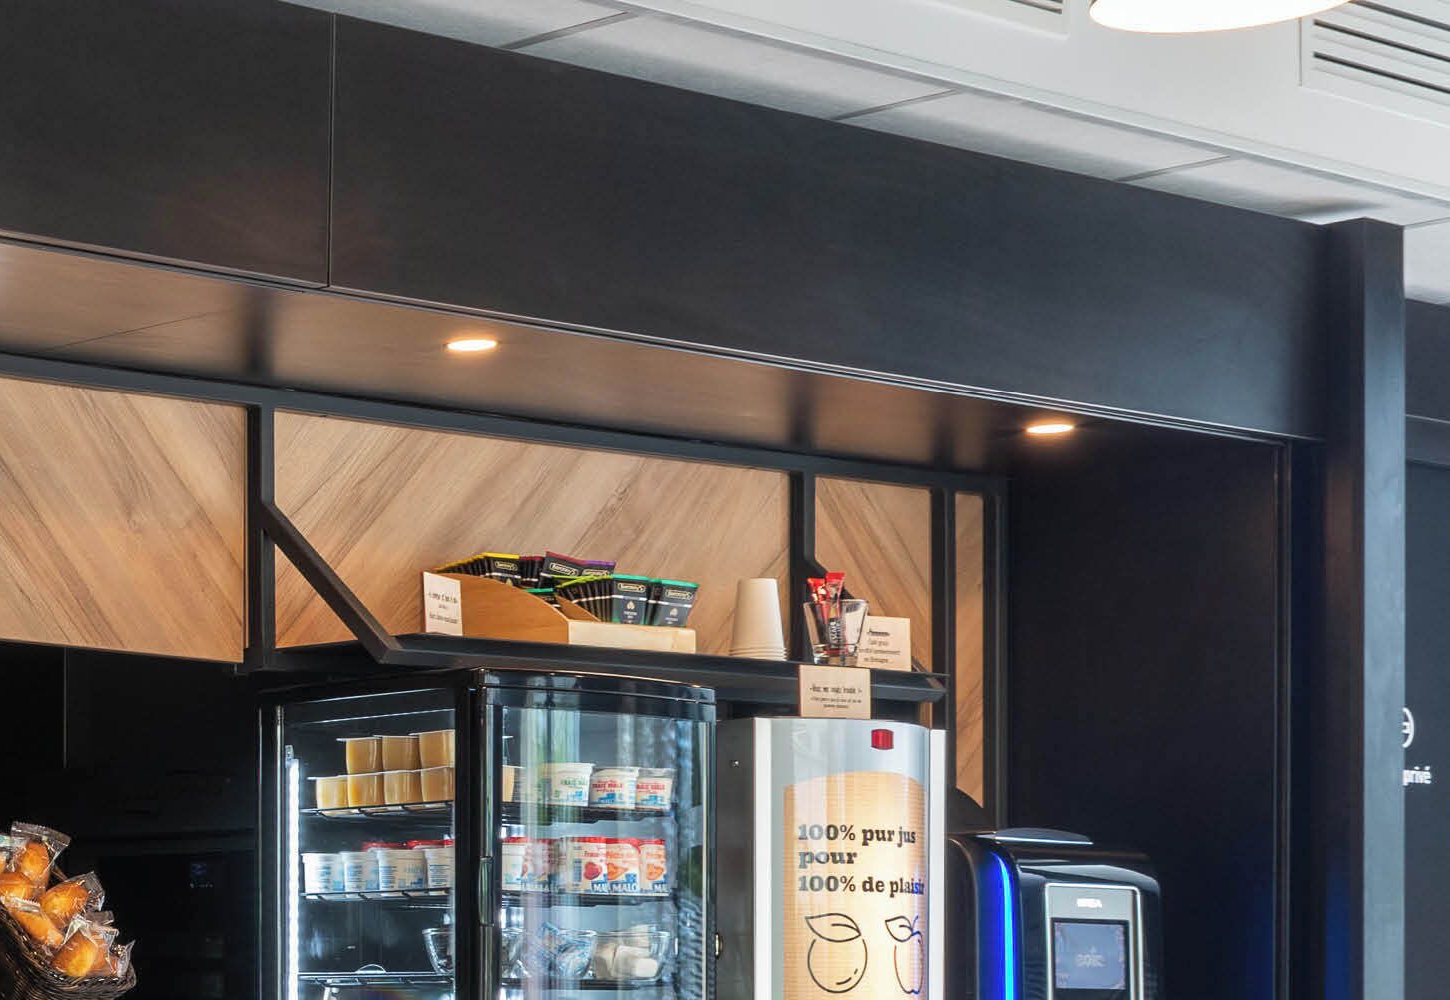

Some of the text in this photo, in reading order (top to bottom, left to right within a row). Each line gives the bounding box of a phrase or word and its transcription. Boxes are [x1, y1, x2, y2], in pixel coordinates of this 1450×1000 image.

[798, 824, 916, 848] 100% pur jus
[798, 851, 857, 869] pour
[798, 875, 856, 892] 100%
[862, 876, 885, 892] de
